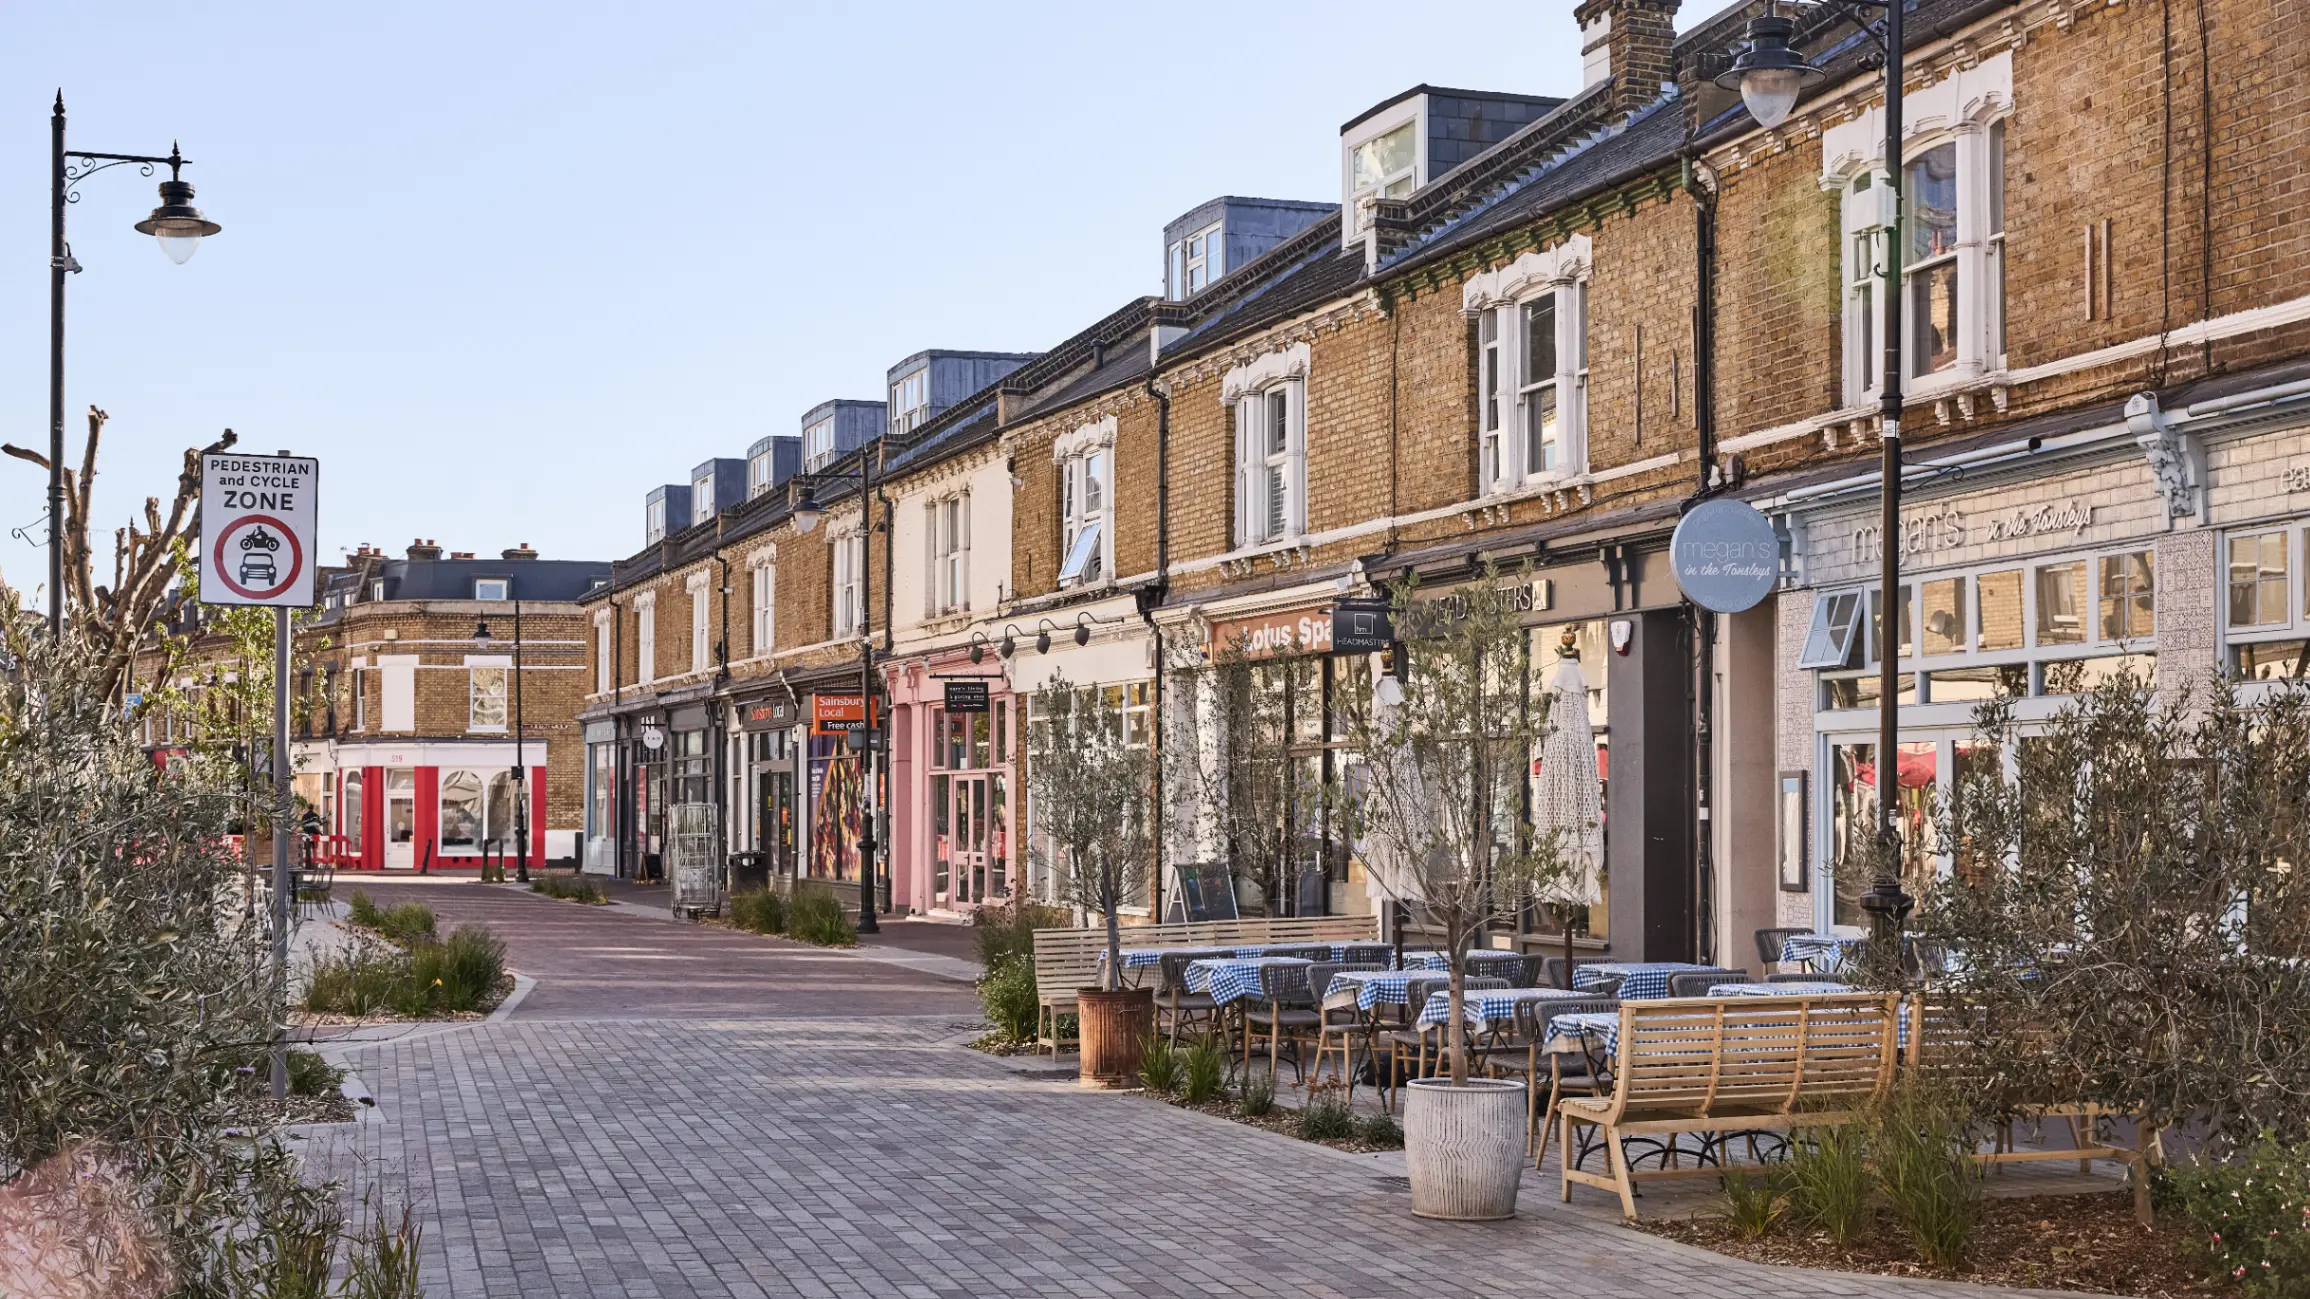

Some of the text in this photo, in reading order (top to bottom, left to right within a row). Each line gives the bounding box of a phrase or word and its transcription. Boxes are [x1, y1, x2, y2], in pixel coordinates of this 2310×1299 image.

[210, 459, 310, 475] PEDESTRIAN
[219, 475, 300, 489] and CYCLE
[223, 490, 294, 511] ZONE
[2004, 508, 2027, 537] the
[2030, 499, 2092, 538] Tonsleys
[1682, 539, 1771, 564] megan's
[1684, 562, 1771, 581] in the Tonsleys
[1243, 622, 1292, 652] Lotus
[772, 700, 785, 718] Local
[819, 707, 844, 718] Local
[827, 721, 845, 730] Free
[391, 754, 403, 763] 519
